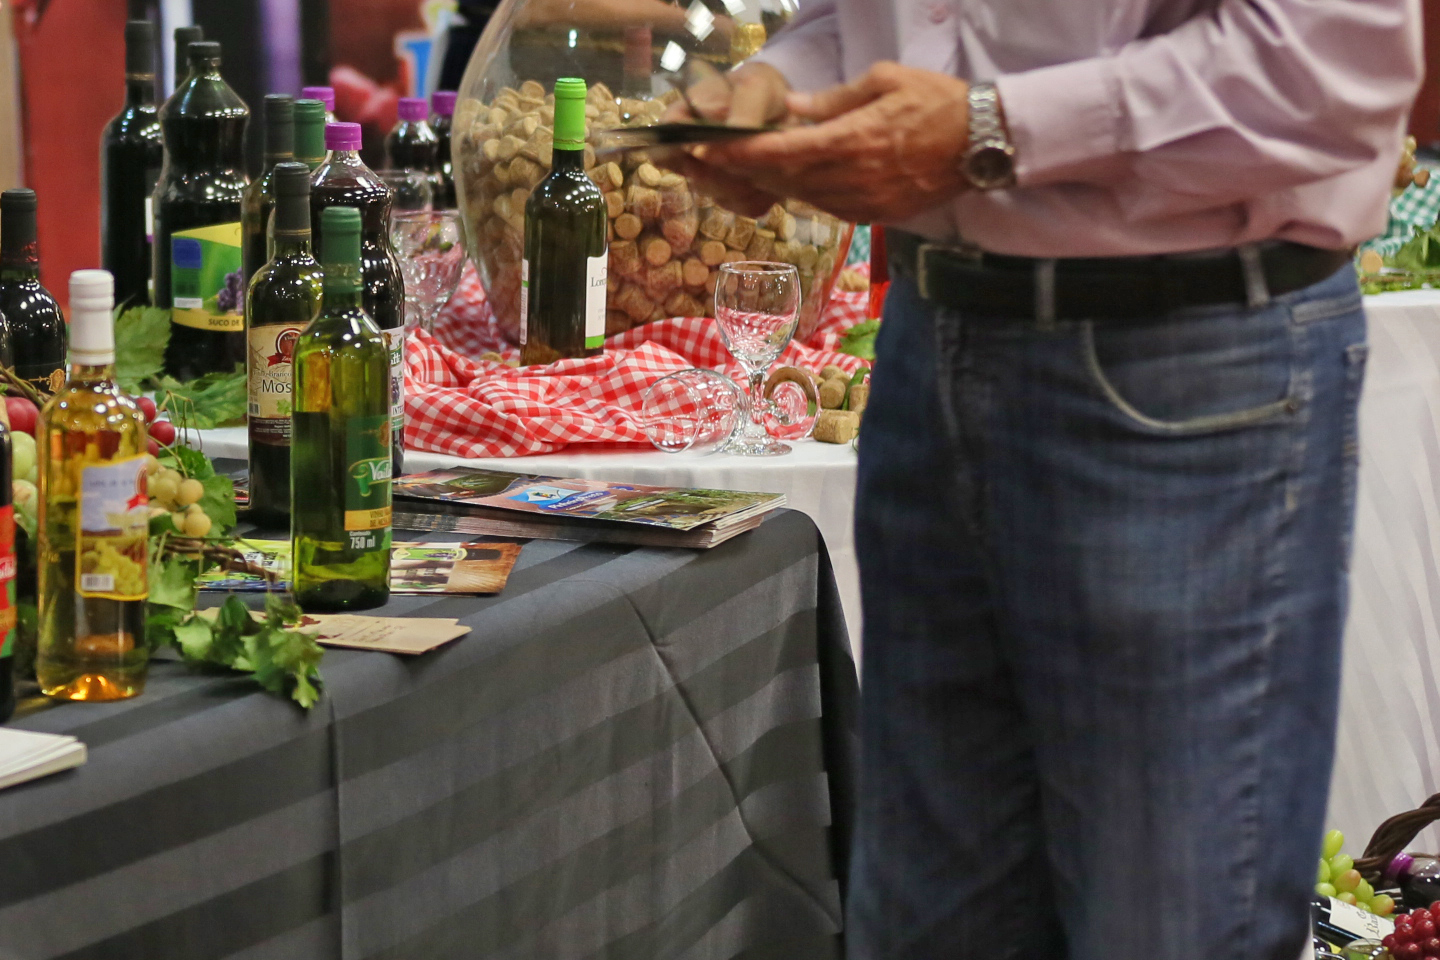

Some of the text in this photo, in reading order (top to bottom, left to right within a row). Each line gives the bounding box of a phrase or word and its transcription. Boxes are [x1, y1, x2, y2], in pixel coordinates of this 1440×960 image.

[208, 318, 230, 327] SUCO
[262, 379, 293, 394] Mos
[350, 535, 376, 549] 750 ml
